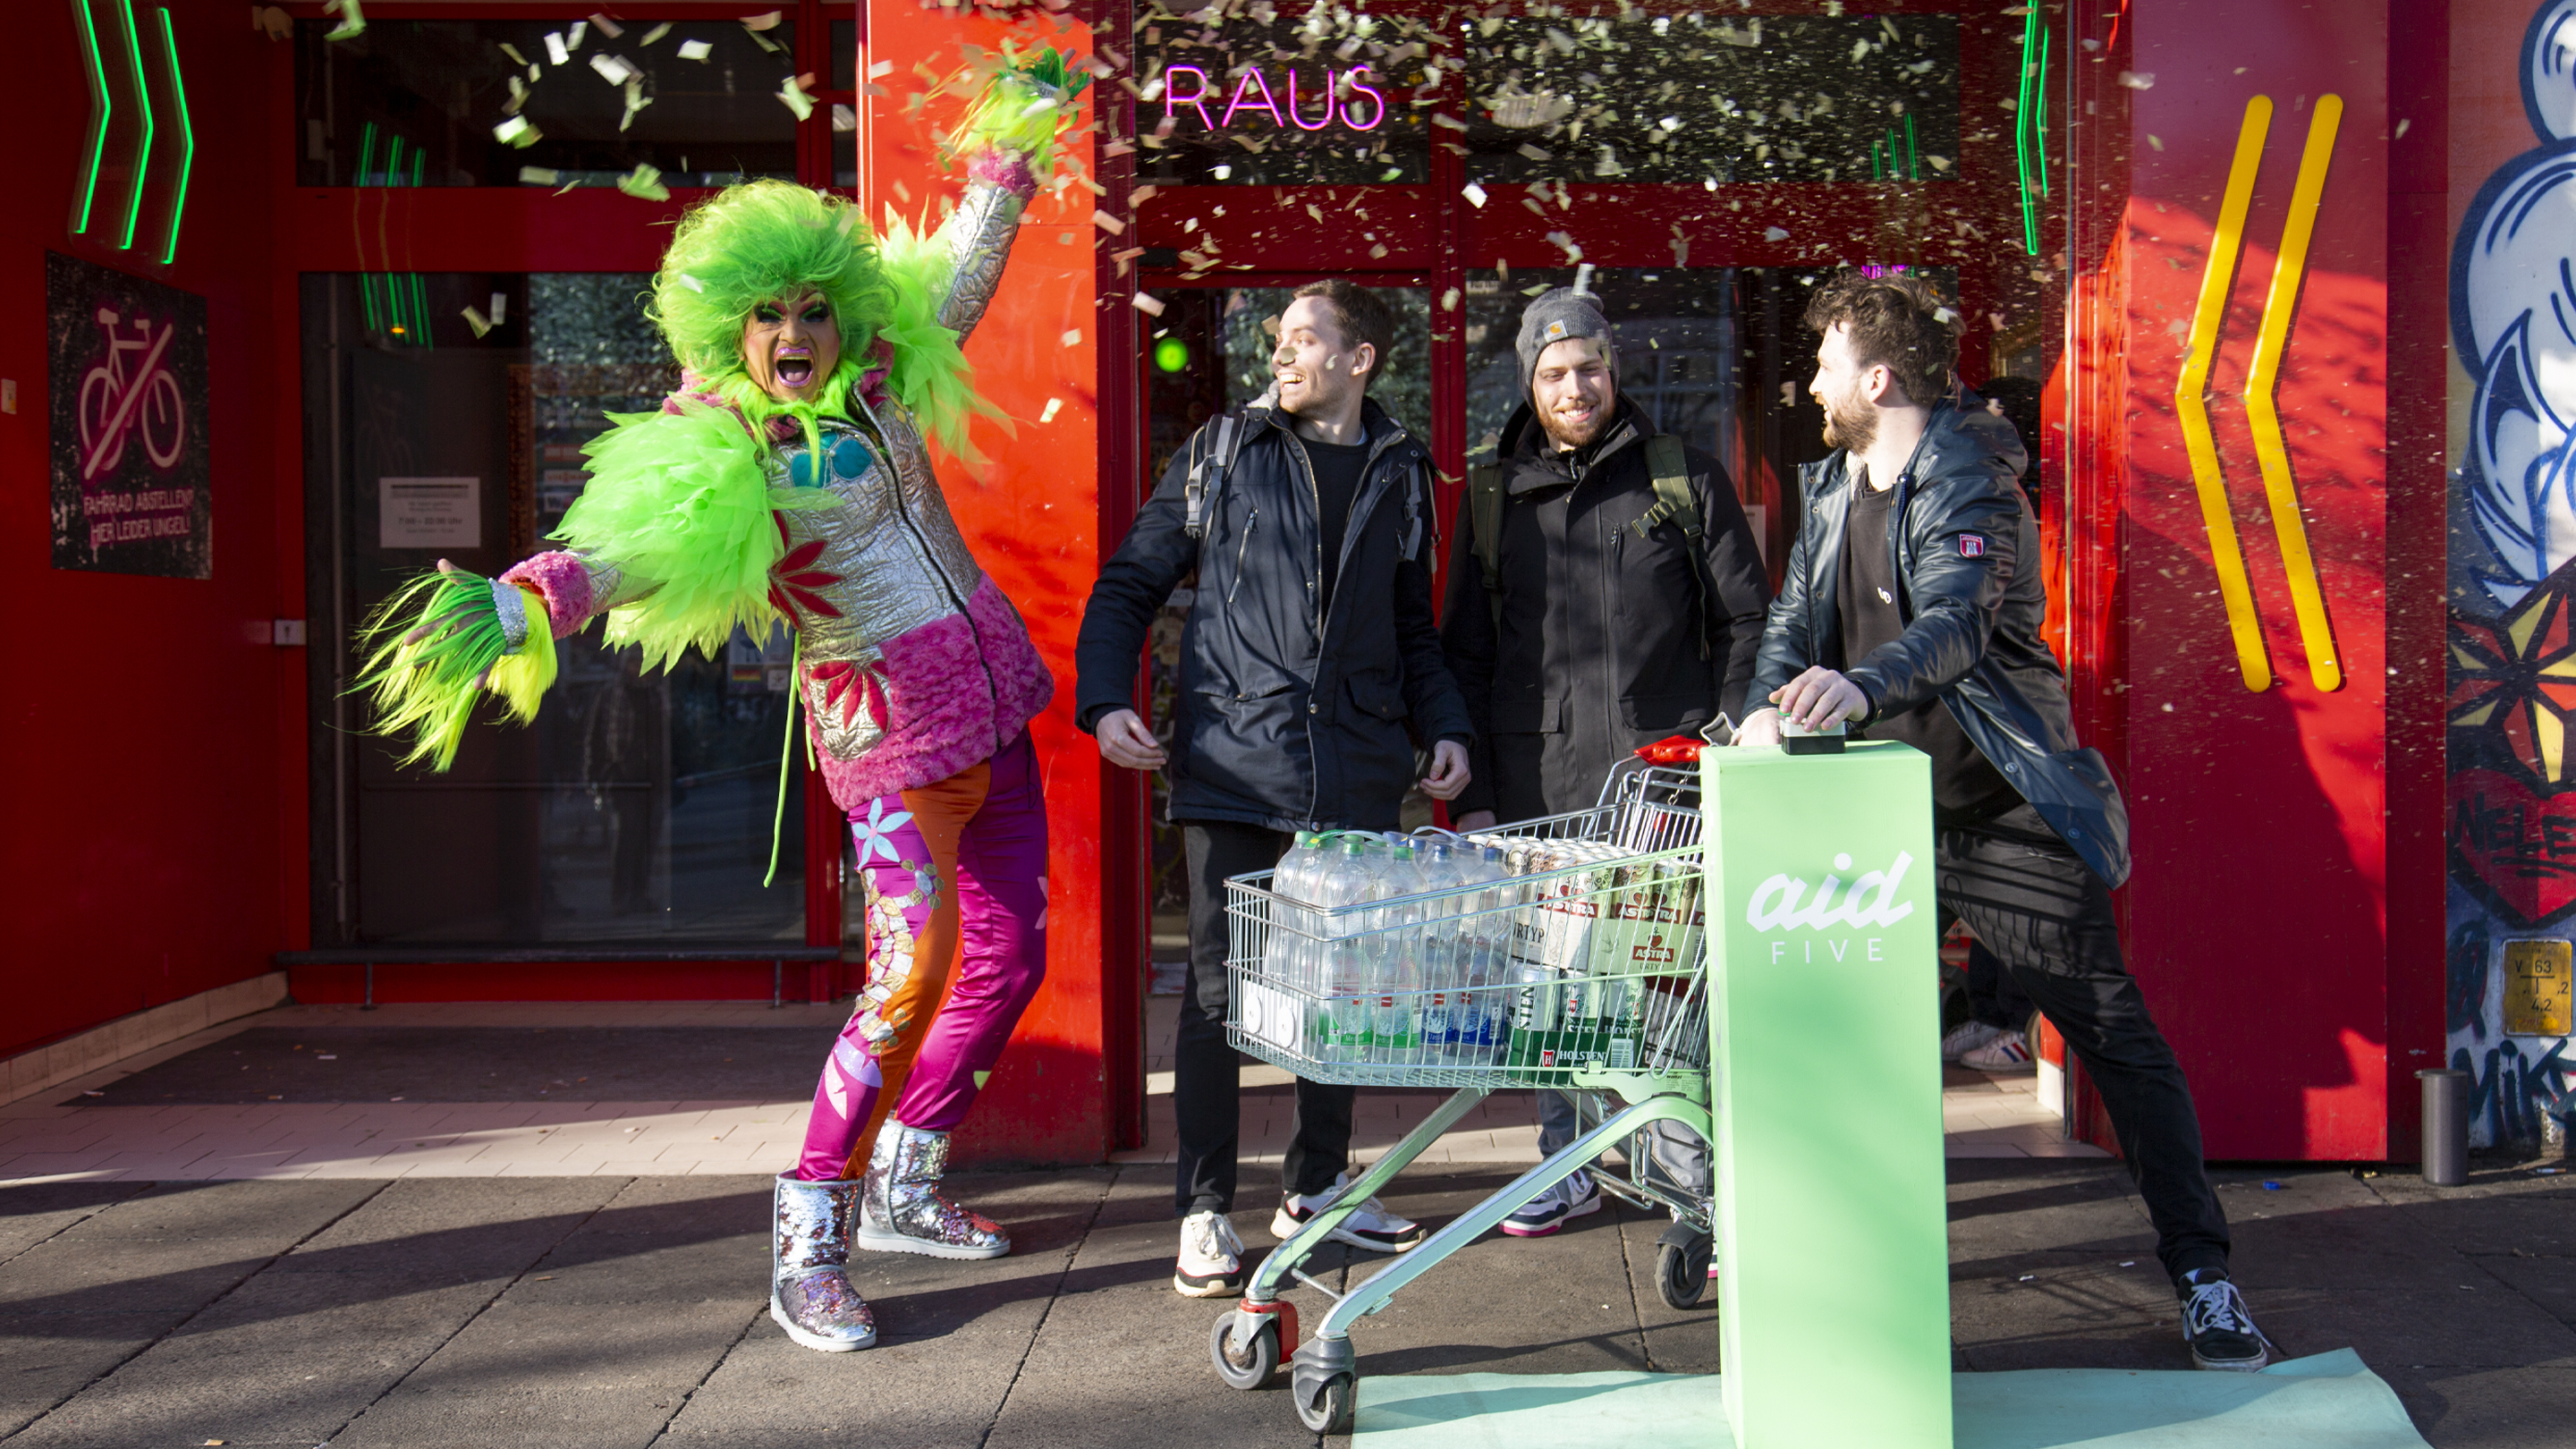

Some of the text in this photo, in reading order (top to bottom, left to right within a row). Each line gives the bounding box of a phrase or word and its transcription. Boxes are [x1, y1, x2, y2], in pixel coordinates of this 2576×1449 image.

[1165, 64, 1385, 131] RAUS
[83, 493, 134, 516] FAHRRAD
[90, 522, 115, 543] HIER
[116, 519, 153, 541] LEIDER
[1747, 850, 1914, 933] aid
[1635, 948, 1671, 960] ASTRA
[1772, 937, 1884, 965] FIVE
[2515, 960, 2552, 973] V 63
[1559, 1050, 1606, 1061] HOLSTEN
